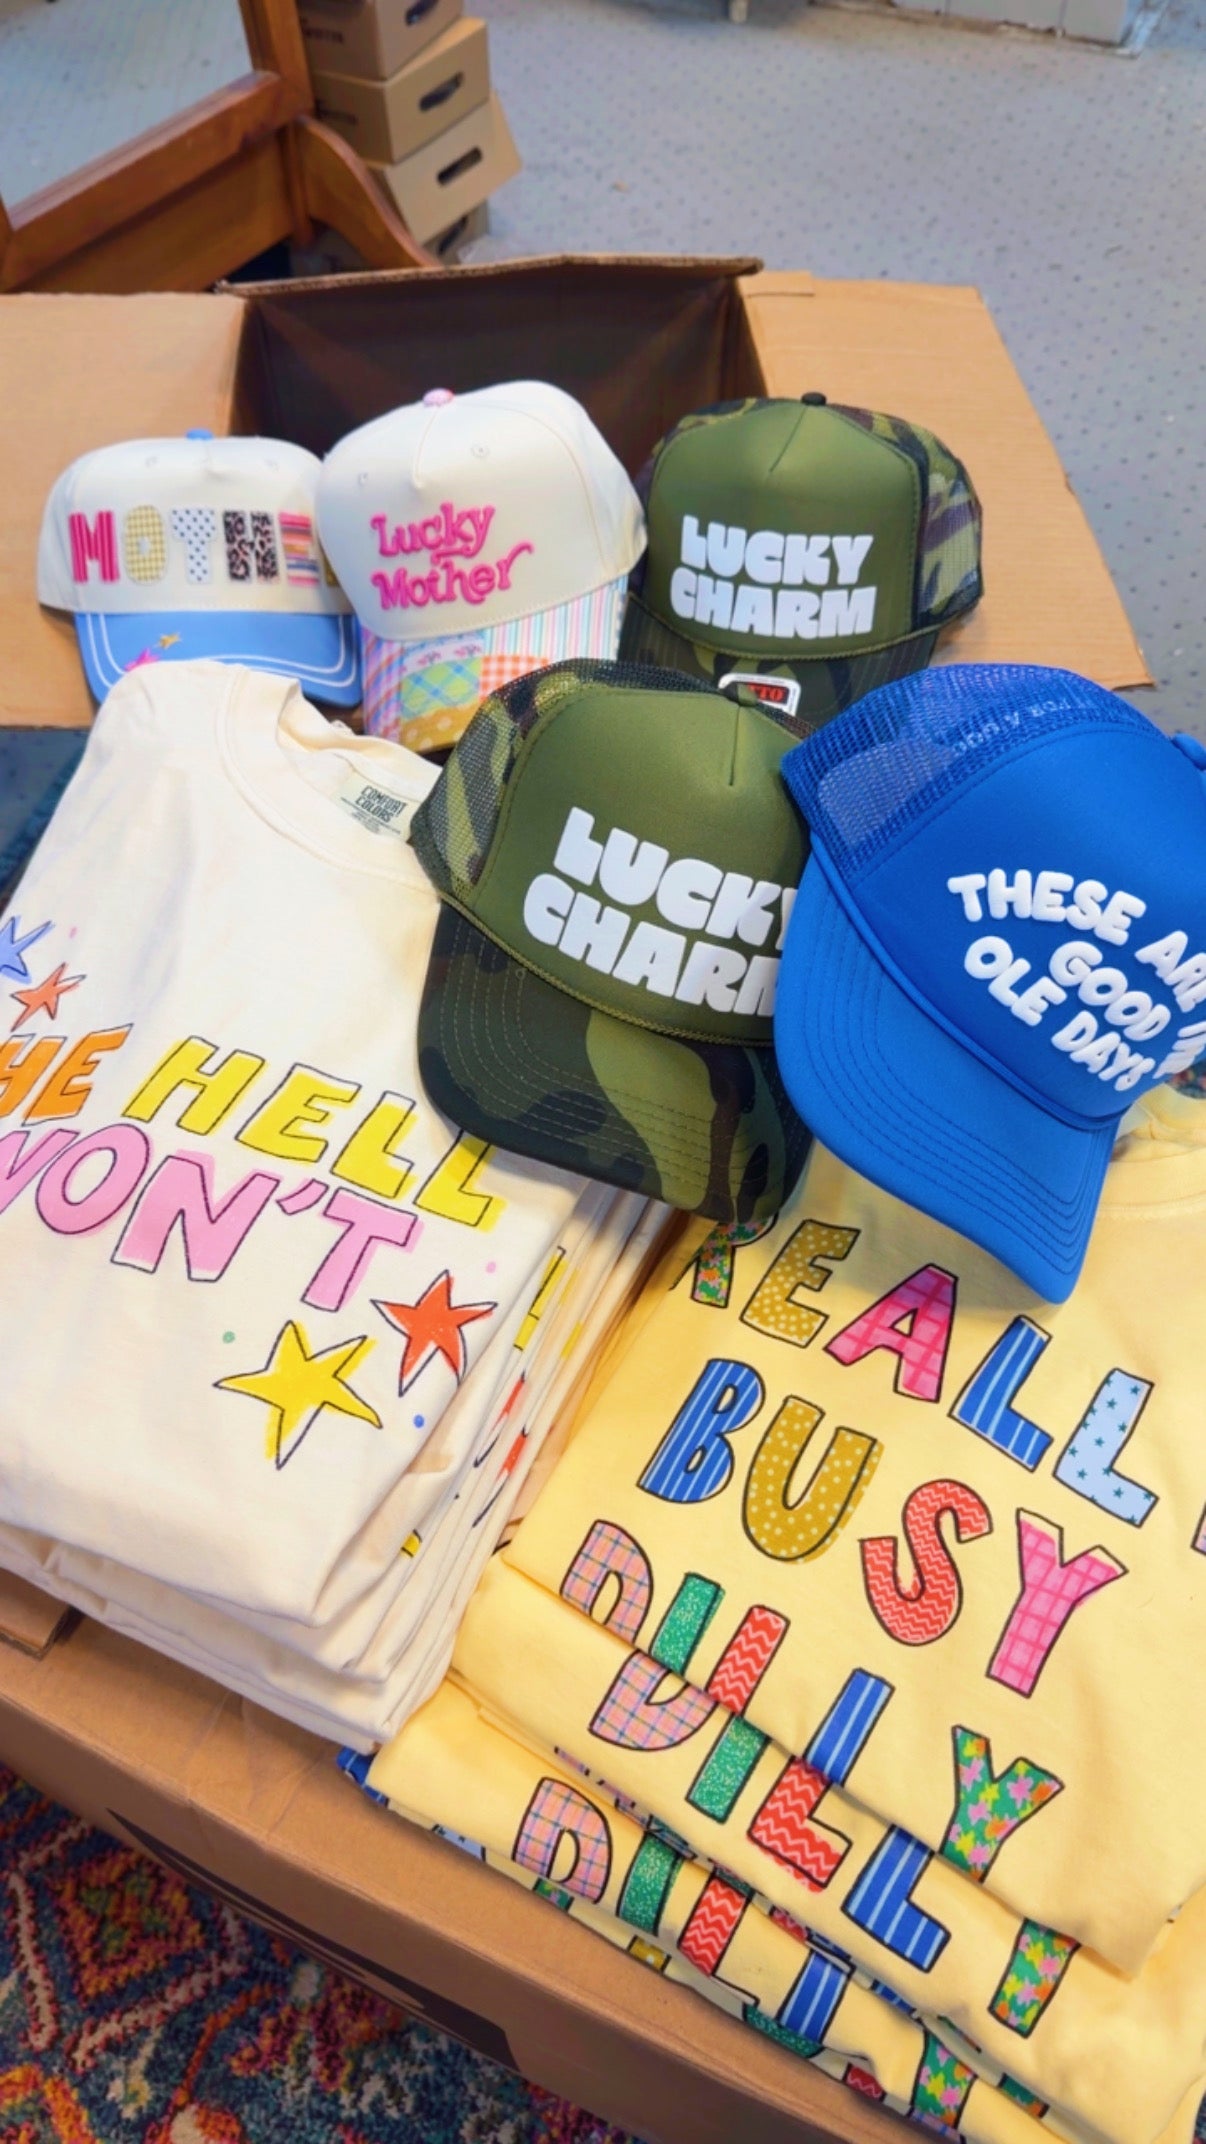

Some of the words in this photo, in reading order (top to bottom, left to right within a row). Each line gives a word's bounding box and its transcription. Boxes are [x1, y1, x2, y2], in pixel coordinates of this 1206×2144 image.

[370, 502, 496, 566] Lucky
[680, 514, 874, 586] LUCKY
[371, 541, 535, 612] Mother
[670, 566, 878, 640] CHARM
[355, 795, 393, 823] COLORS
[361, 785, 407, 817] COMFORT
[947, 868, 1147, 946] THESE
[964, 935, 1067, 1026] OLE
[1051, 1010, 1156, 1092] DAYS
[1049, 940, 1171, 1042] GOOD
[121, 1035, 507, 1233] HELL
[668, 1211, 1206, 1556] EALL
[636, 1357, 1129, 1699] BUSY
